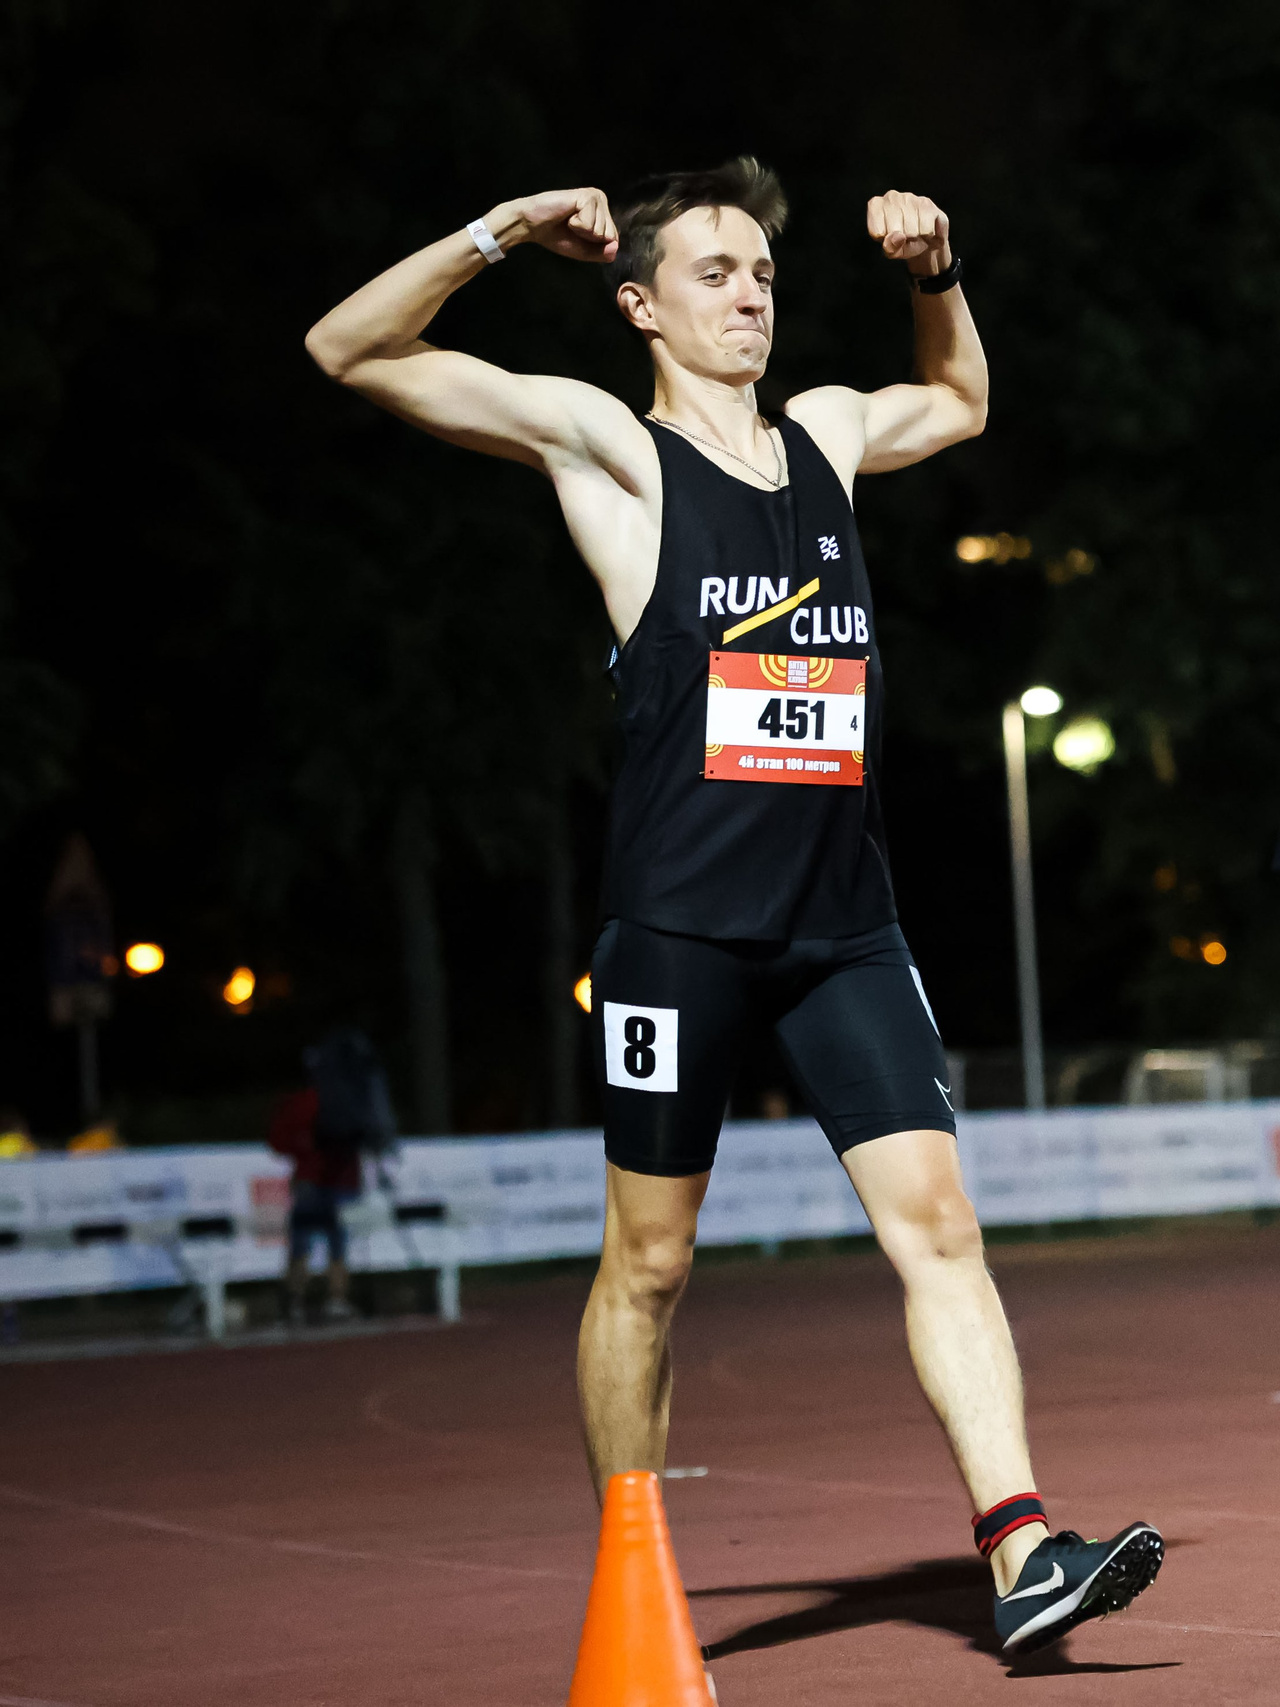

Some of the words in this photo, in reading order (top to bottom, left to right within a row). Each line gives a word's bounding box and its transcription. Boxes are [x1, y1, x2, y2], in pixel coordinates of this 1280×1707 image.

[700, 576, 789, 618] RUN
[790, 606, 869, 645] CLUB
[758, 698, 825, 741] 451
[850, 715, 858, 731] 4
[756, 757, 784, 770] этап
[785, 758, 804, 771] 100
[804, 760, 841, 774] метров
[624, 1016, 656, 1079] 8
